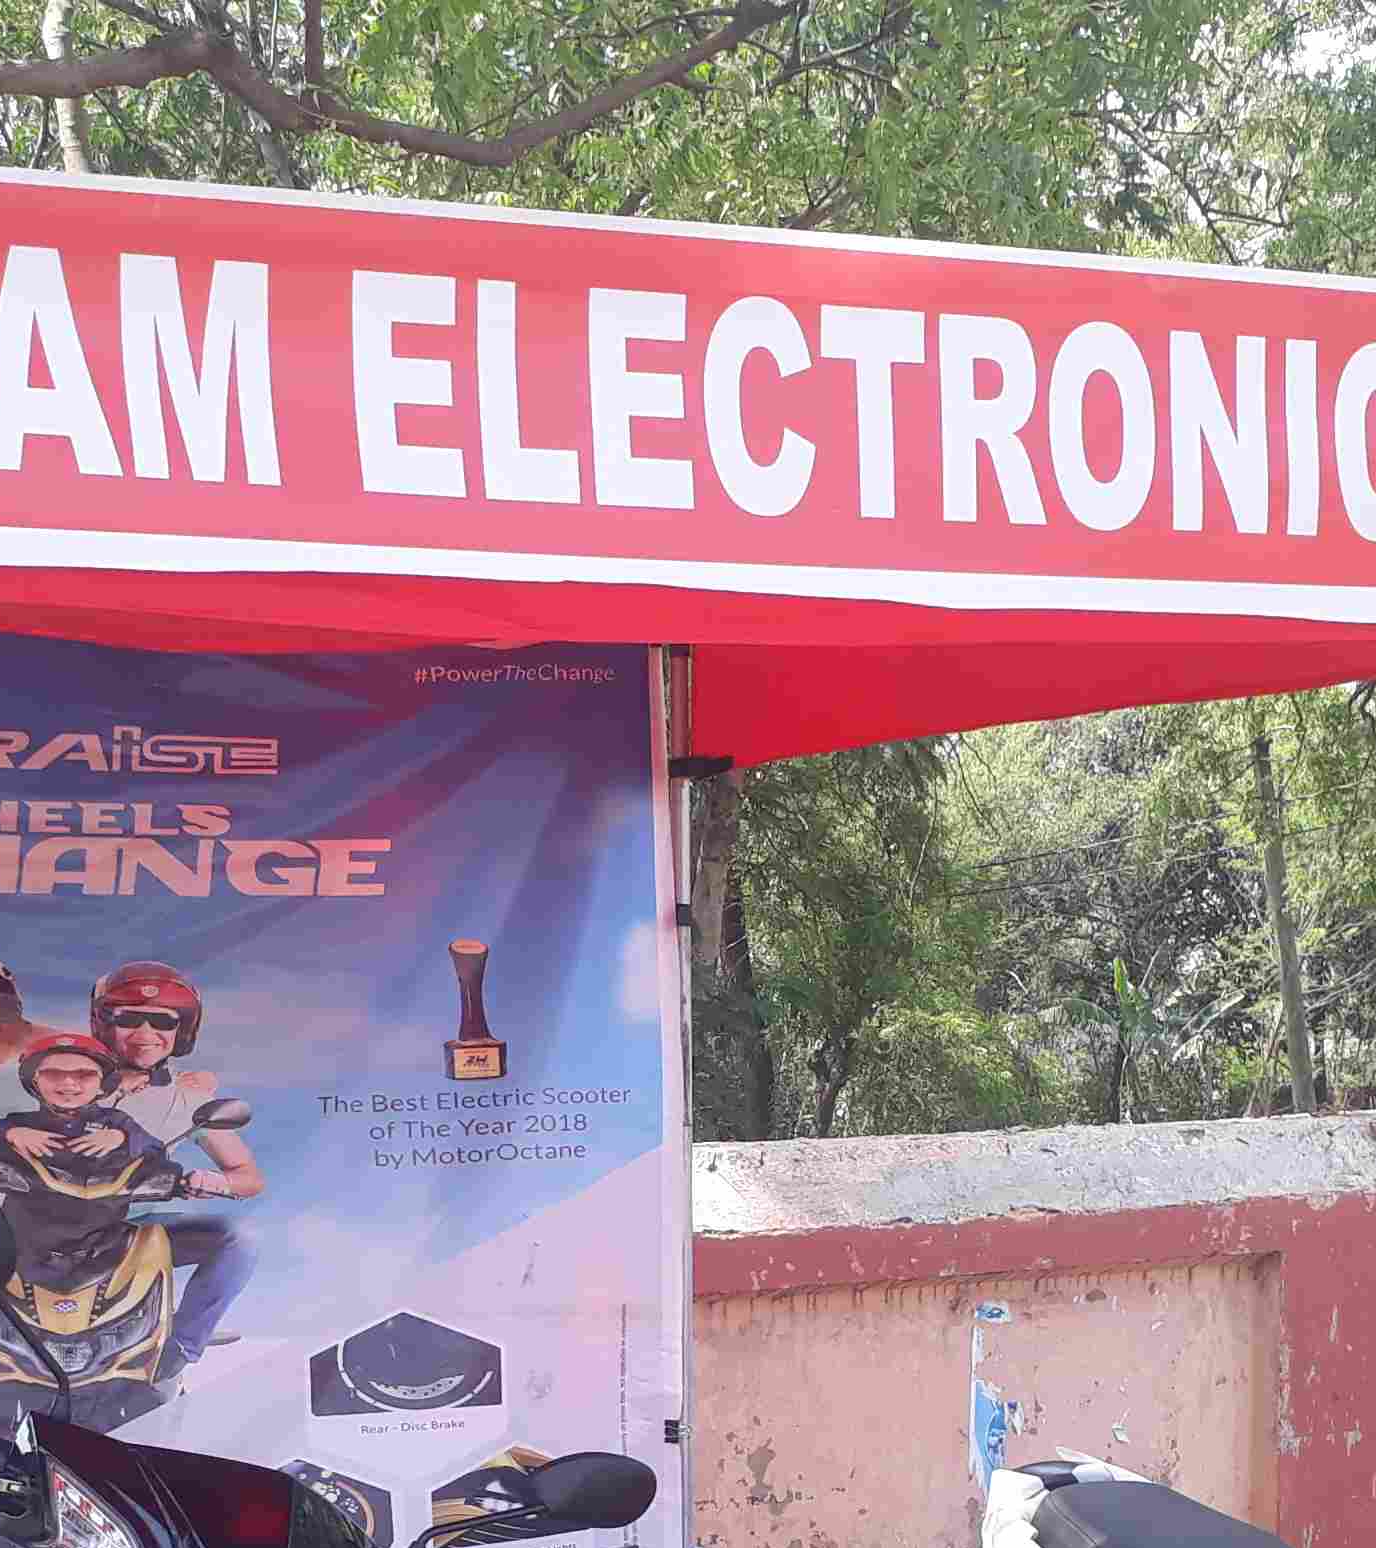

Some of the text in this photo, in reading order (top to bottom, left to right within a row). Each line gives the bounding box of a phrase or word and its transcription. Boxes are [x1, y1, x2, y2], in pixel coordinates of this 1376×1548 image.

[414, 663, 616, 686] #PowerTheChange
[318, 1087, 632, 1114] The Best Electric Scooter
[369, 1113, 587, 1140] of The Year 2018
[375, 1143, 587, 1170] by MotorOctane
[360, 1425, 389, 1434] Rear
[401, 1422, 427, 1432] Disc
[431, 1419, 465, 1430] Brake
